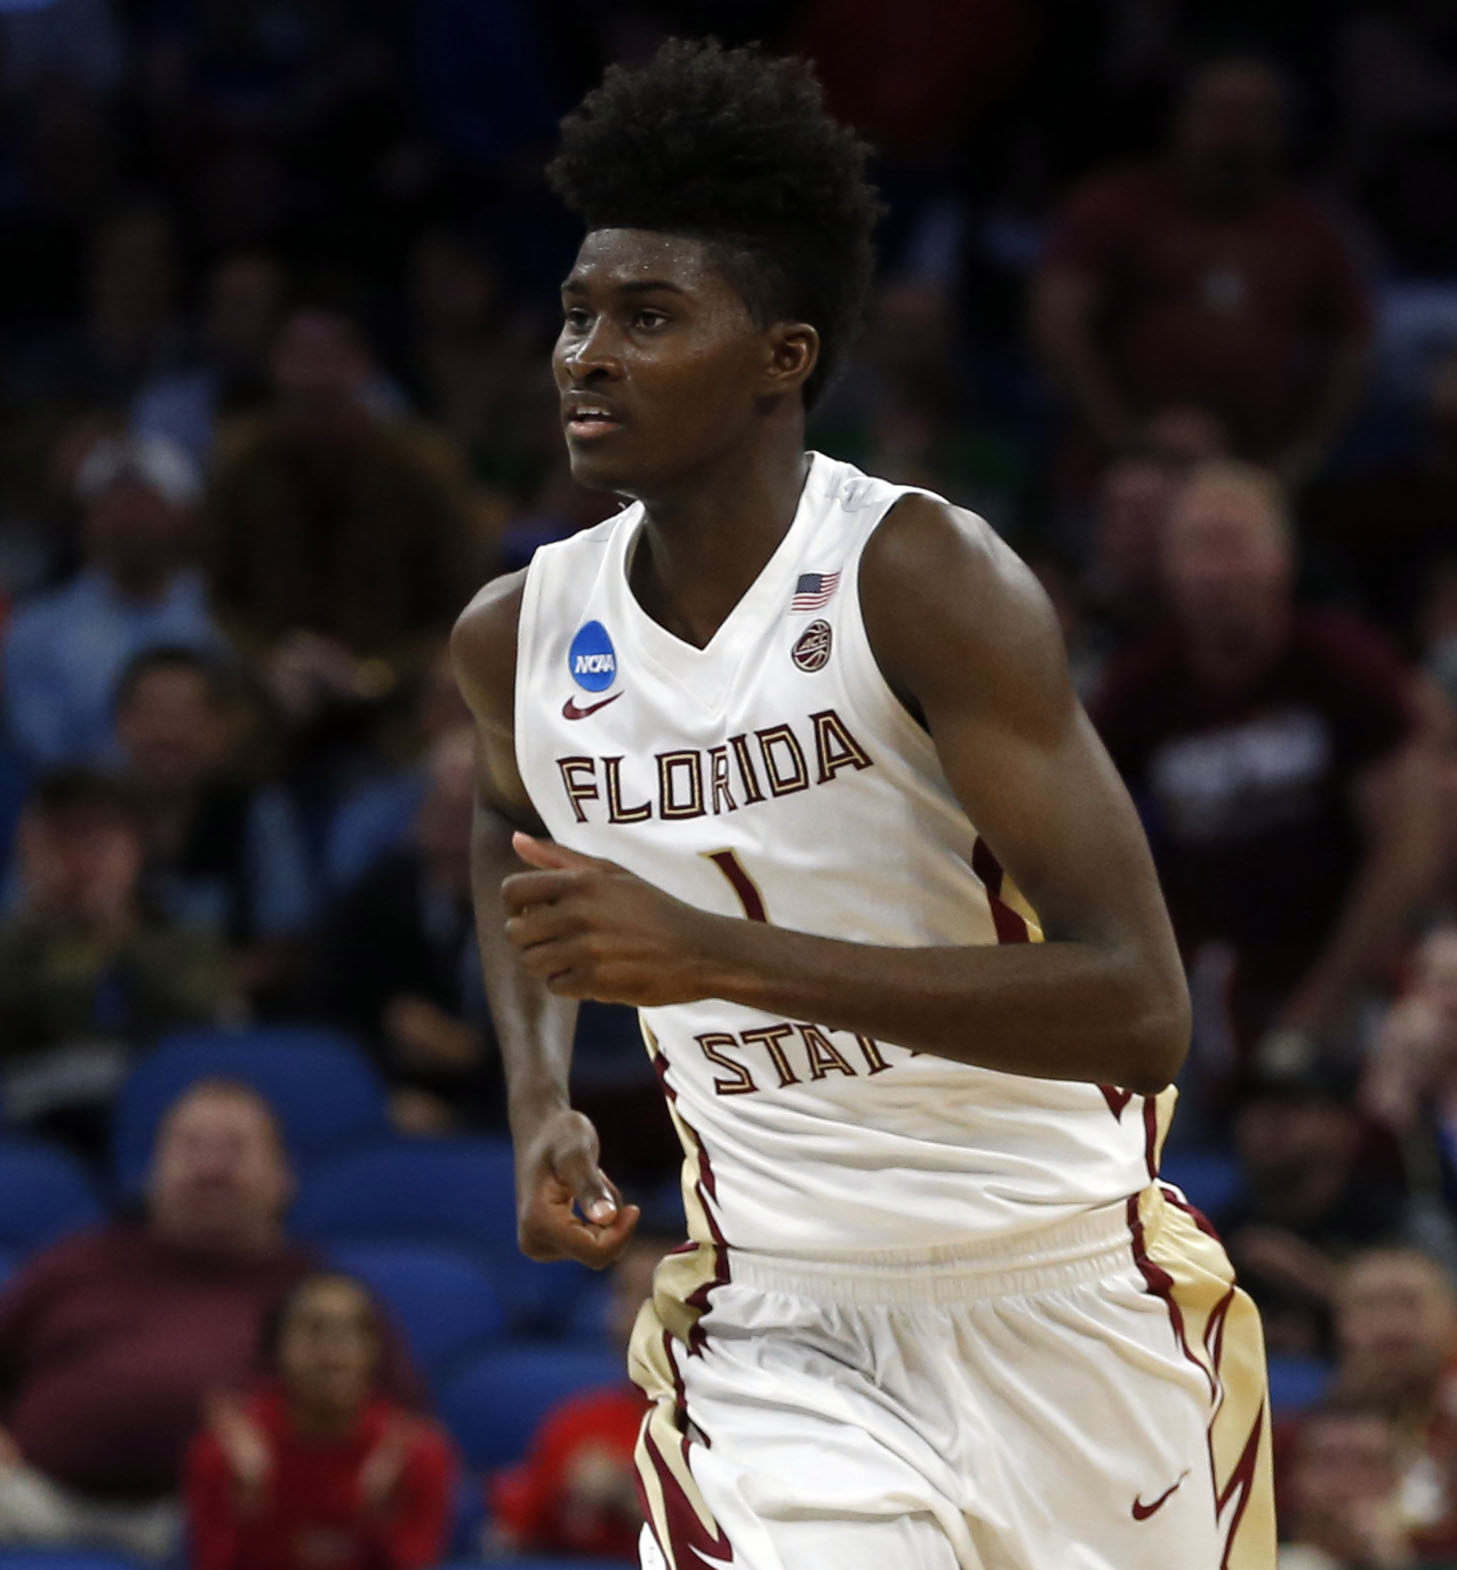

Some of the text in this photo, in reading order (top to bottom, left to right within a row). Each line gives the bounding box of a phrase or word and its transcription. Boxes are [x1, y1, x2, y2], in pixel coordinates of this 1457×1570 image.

[574, 653, 614, 674] NCAA
[557, 709, 874, 824] FLORIDA
[694, 1023, 922, 1095] STAT
